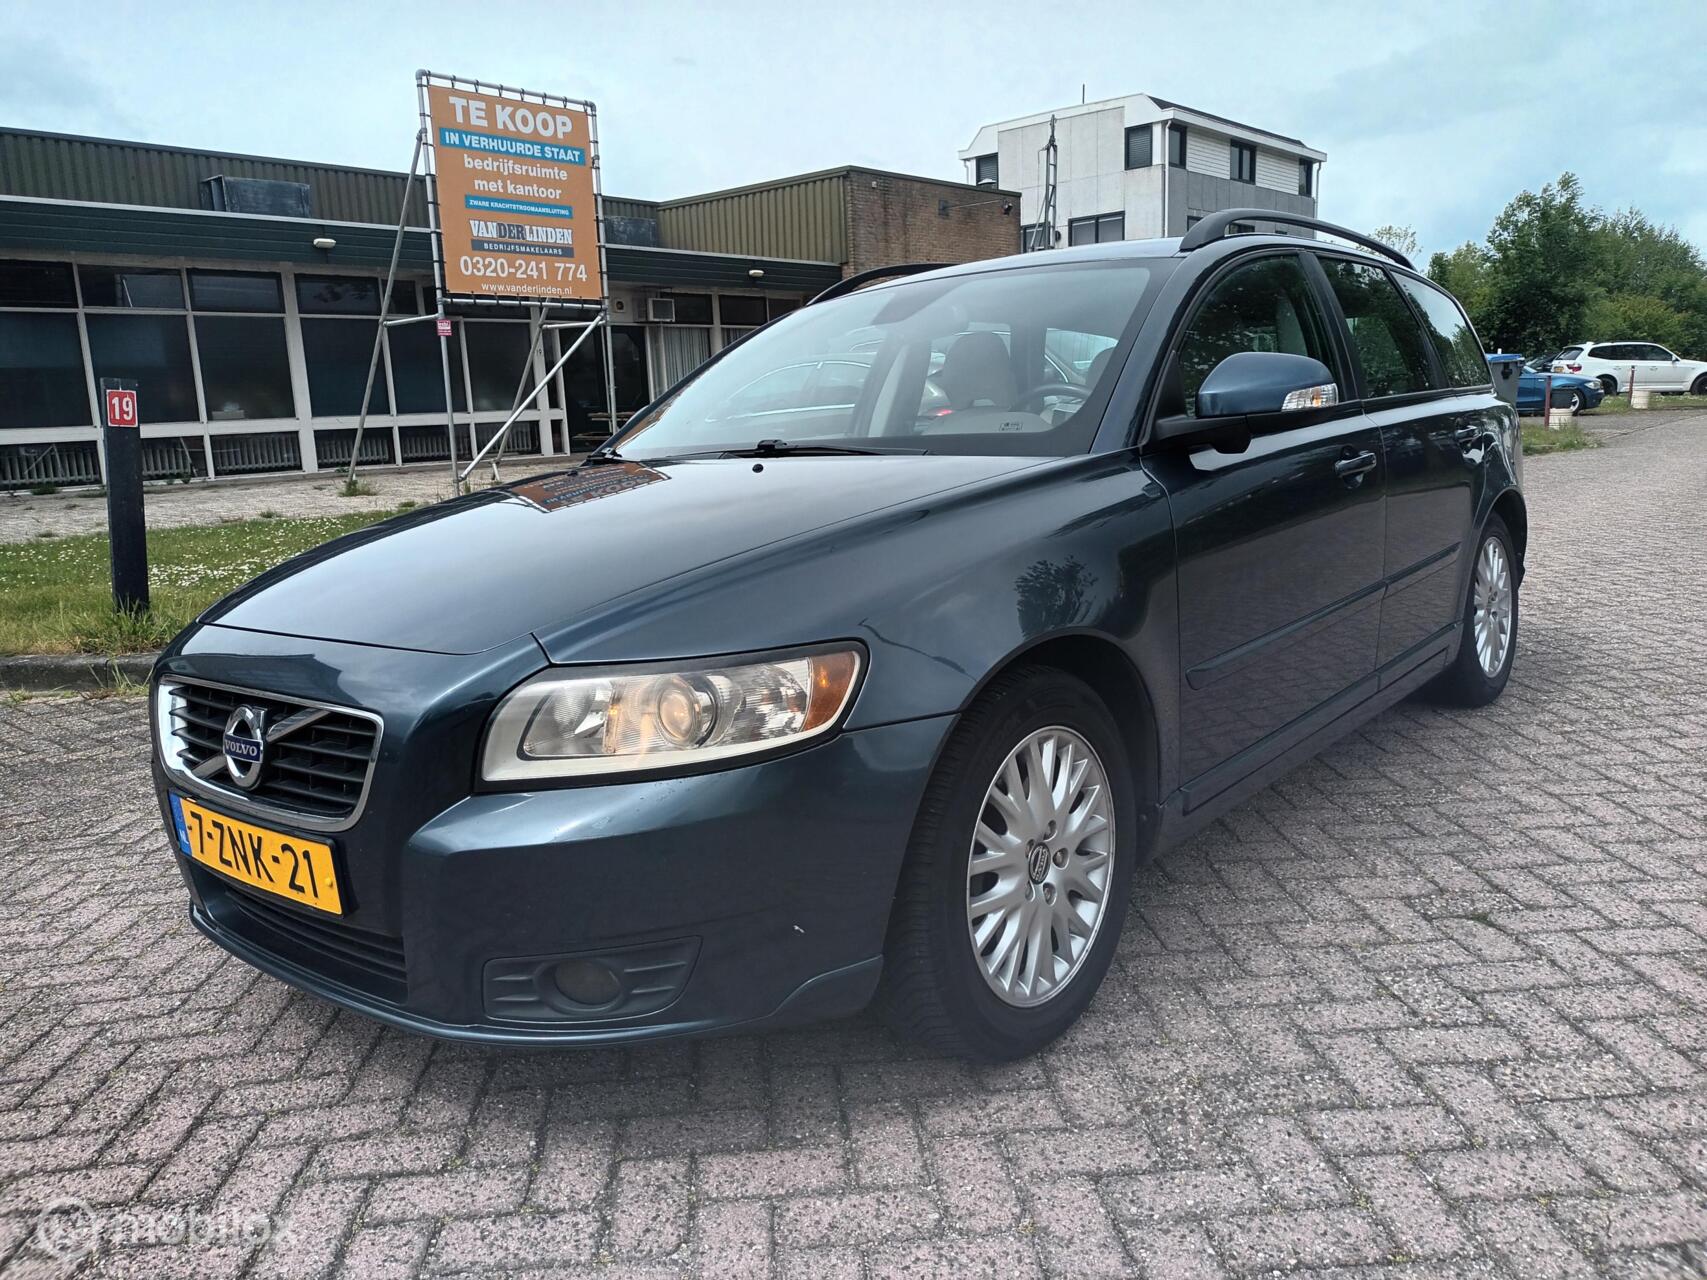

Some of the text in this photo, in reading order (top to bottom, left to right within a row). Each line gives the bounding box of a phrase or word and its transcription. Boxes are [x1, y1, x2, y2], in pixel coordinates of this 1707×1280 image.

[449, 96, 573, 139] TE KOOP
[445, 131, 580, 162] IN VERHUURDE STAAT
[464, 154, 568, 181] bedrijfsruimte
[474, 178, 562, 199] met kantoor
[469, 199, 490, 207] ZWARE
[483, 243, 563, 255] BEDRIJFSMAKELAARS
[460, 255, 588, 282] 0320-241 774
[481, 283, 573, 295] www.vanderlinden.nl
[111, 396, 133, 421] 19
[225, 739, 258, 757] VOLVO
[179, 829, 190, 845] NL
[190, 812, 319, 899] 7-ZNK-21
